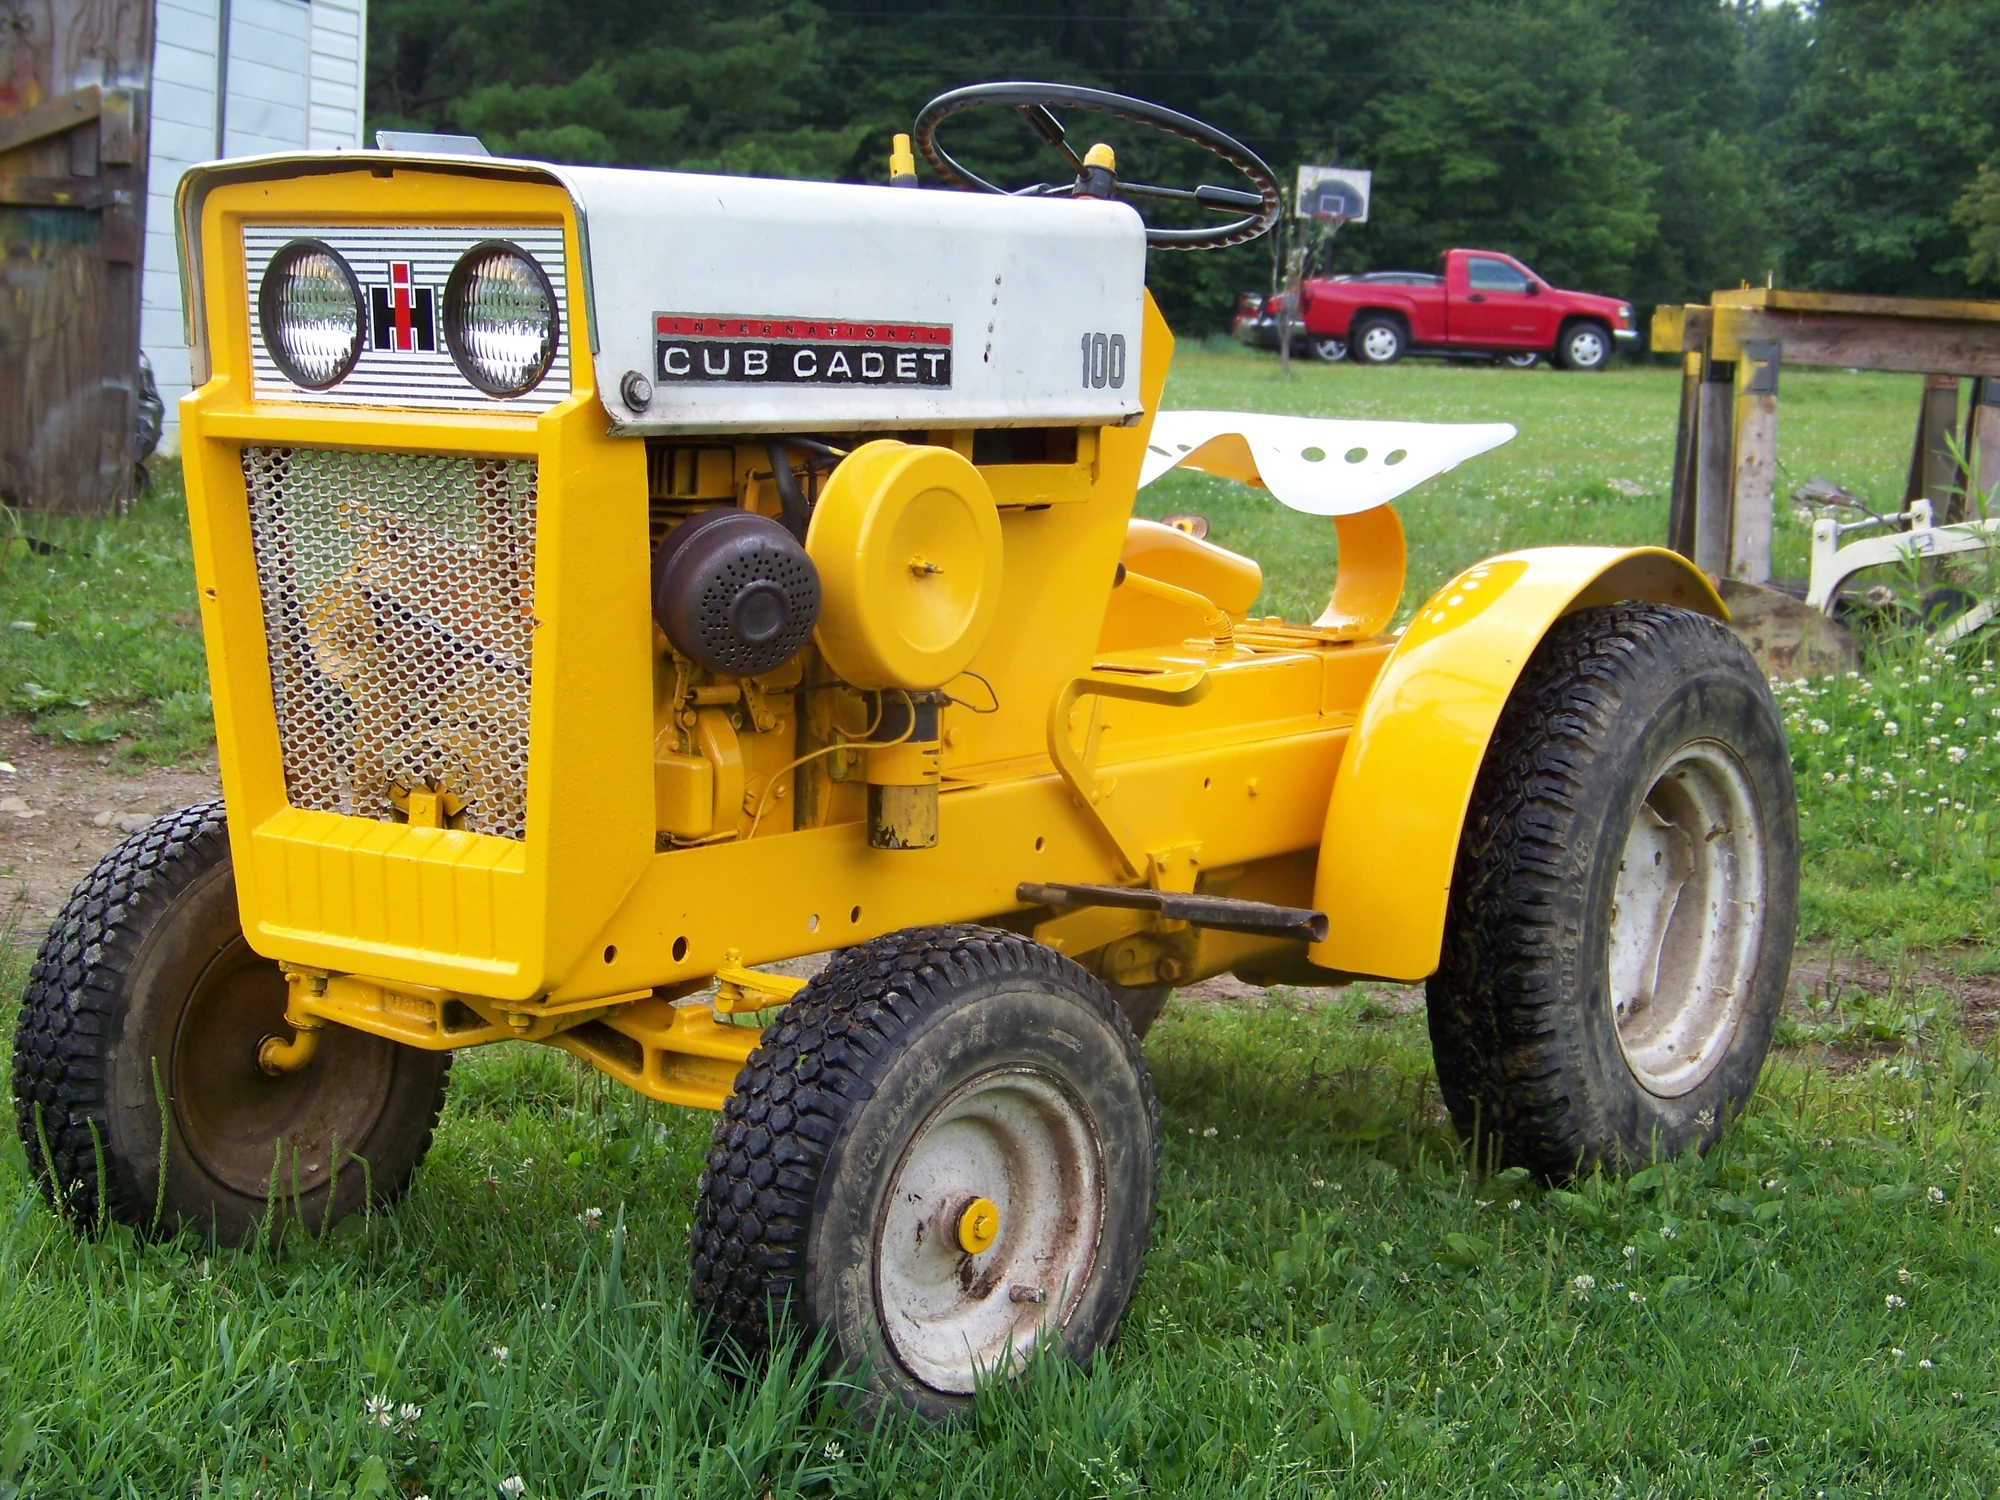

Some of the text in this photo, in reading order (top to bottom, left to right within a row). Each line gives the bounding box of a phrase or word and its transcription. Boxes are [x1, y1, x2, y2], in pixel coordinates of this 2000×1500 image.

[673, 321, 937, 340] INTERNATIONAL
[664, 347, 945, 379] CUB CADET
[1081, 332, 1127, 389] 100
